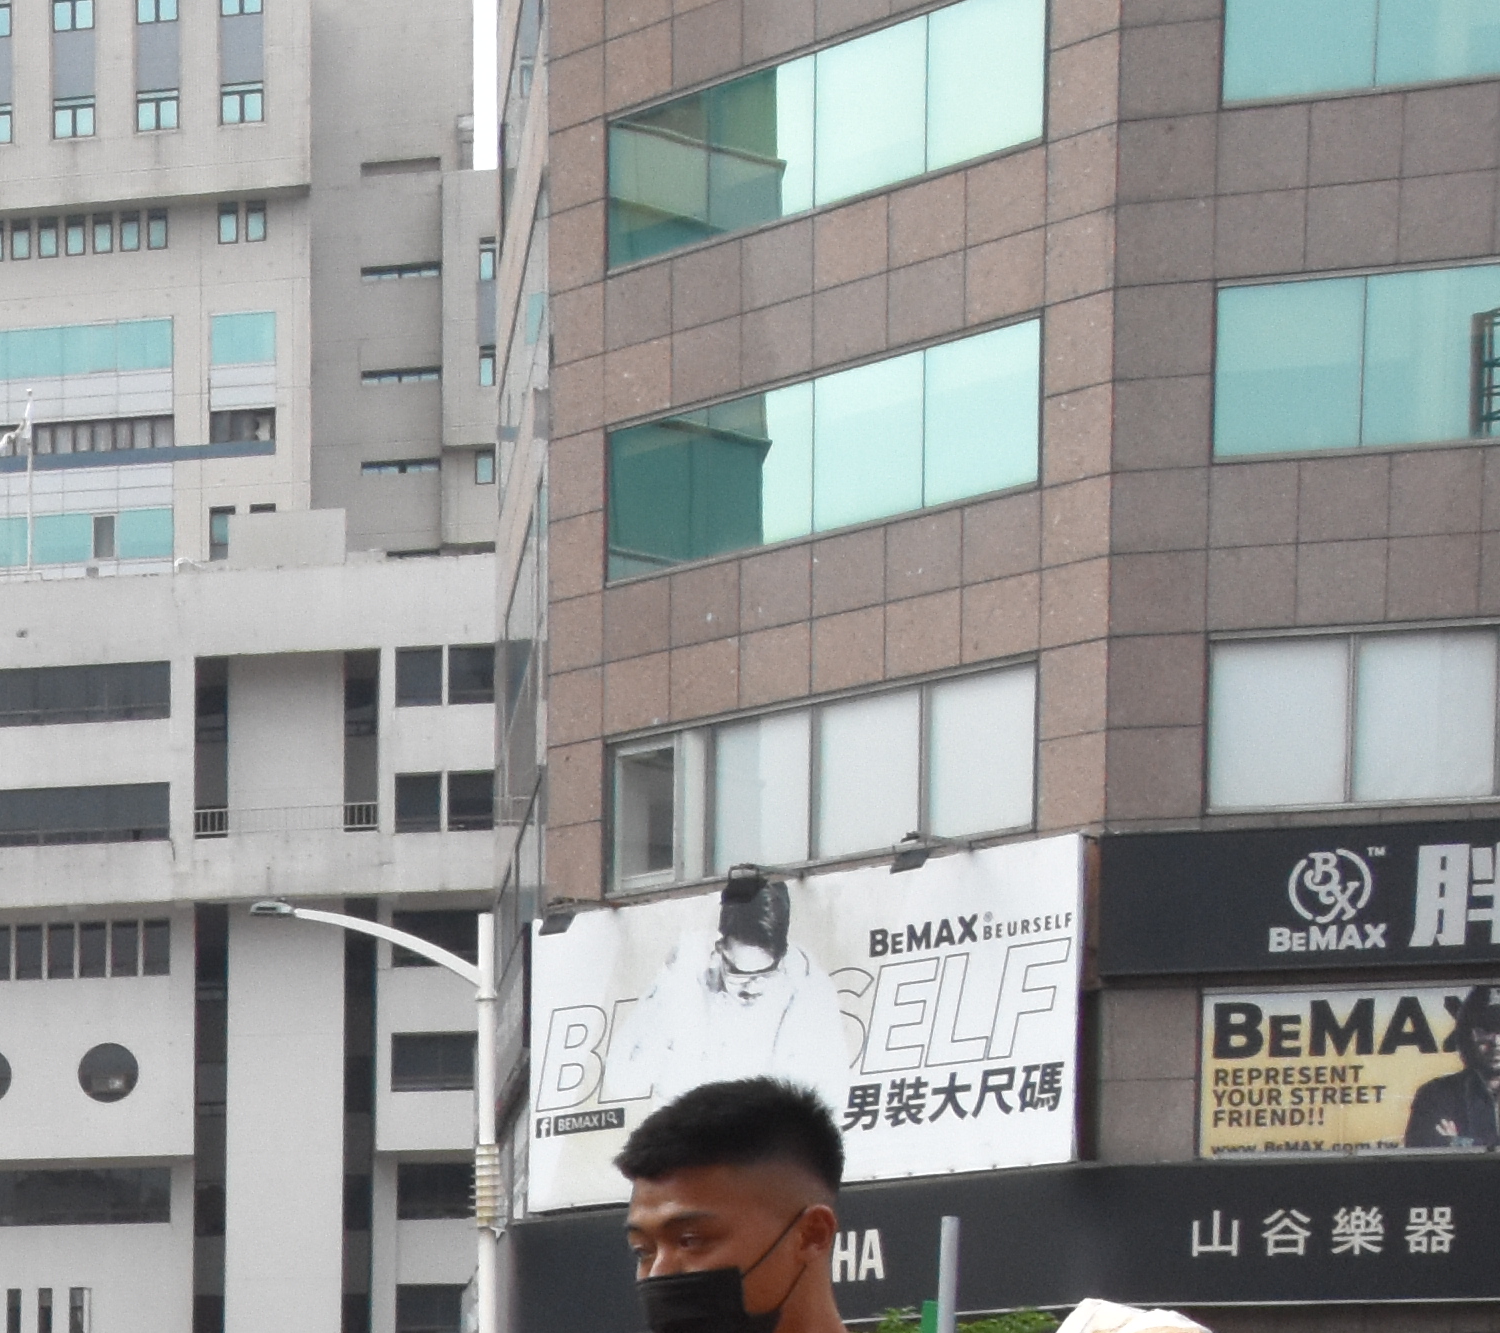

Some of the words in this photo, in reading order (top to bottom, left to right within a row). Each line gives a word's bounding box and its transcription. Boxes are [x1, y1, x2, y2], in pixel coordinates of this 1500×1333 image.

[869, 914, 978, 958] BEMAX
[982, 912, 1073, 941] BEURSELF
[1268, 923, 1387, 954] BEMAX
[1213, 1064, 1365, 1088] REPRESENT
[840, 1061, 1065, 1133] 男裝大尺碼
[1213, 1086, 1284, 1110] YOUR
[1290, 1083, 1388, 1107] STREET
[557, 1115, 600, 1133] BEMAX
[1212, 1107, 1327, 1130] FRIEND!!
[1191, 1205, 1456, 1258] 山谷樂器
[832, 1228, 885, 1283] HA
